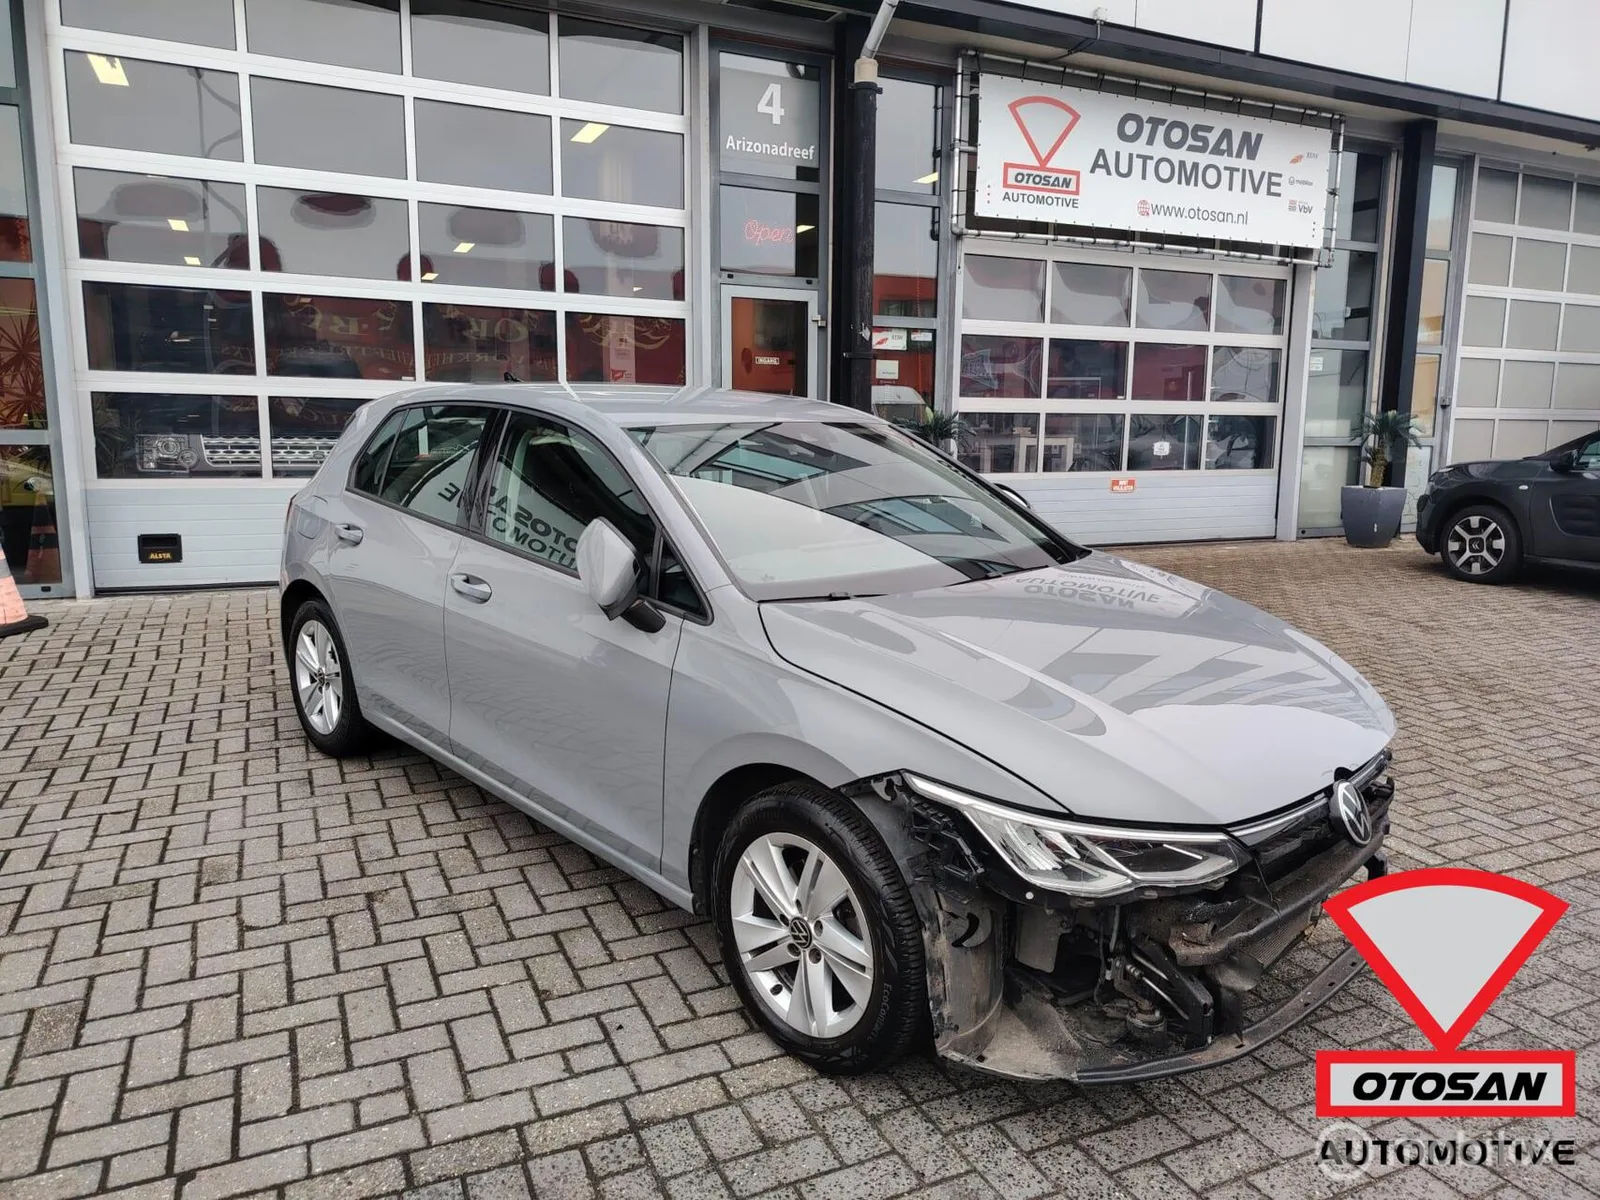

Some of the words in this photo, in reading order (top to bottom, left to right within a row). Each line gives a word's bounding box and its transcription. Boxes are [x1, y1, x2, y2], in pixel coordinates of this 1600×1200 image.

[756, 83, 785, 125] 4
[725, 135, 815, 160] Arizonadreef
[1116, 112, 1264, 161] OTOSAN
[1014, 172, 1072, 188] OTOSAN
[1090, 148, 1284, 198] AUTOMOTIVE
[1002, 192, 1079, 209] AUTOMOTIVE
[1151, 203, 1249, 226] www.otosan.nl
[743, 218, 795, 247] Open
[150, 552, 172, 560] ALSTA
